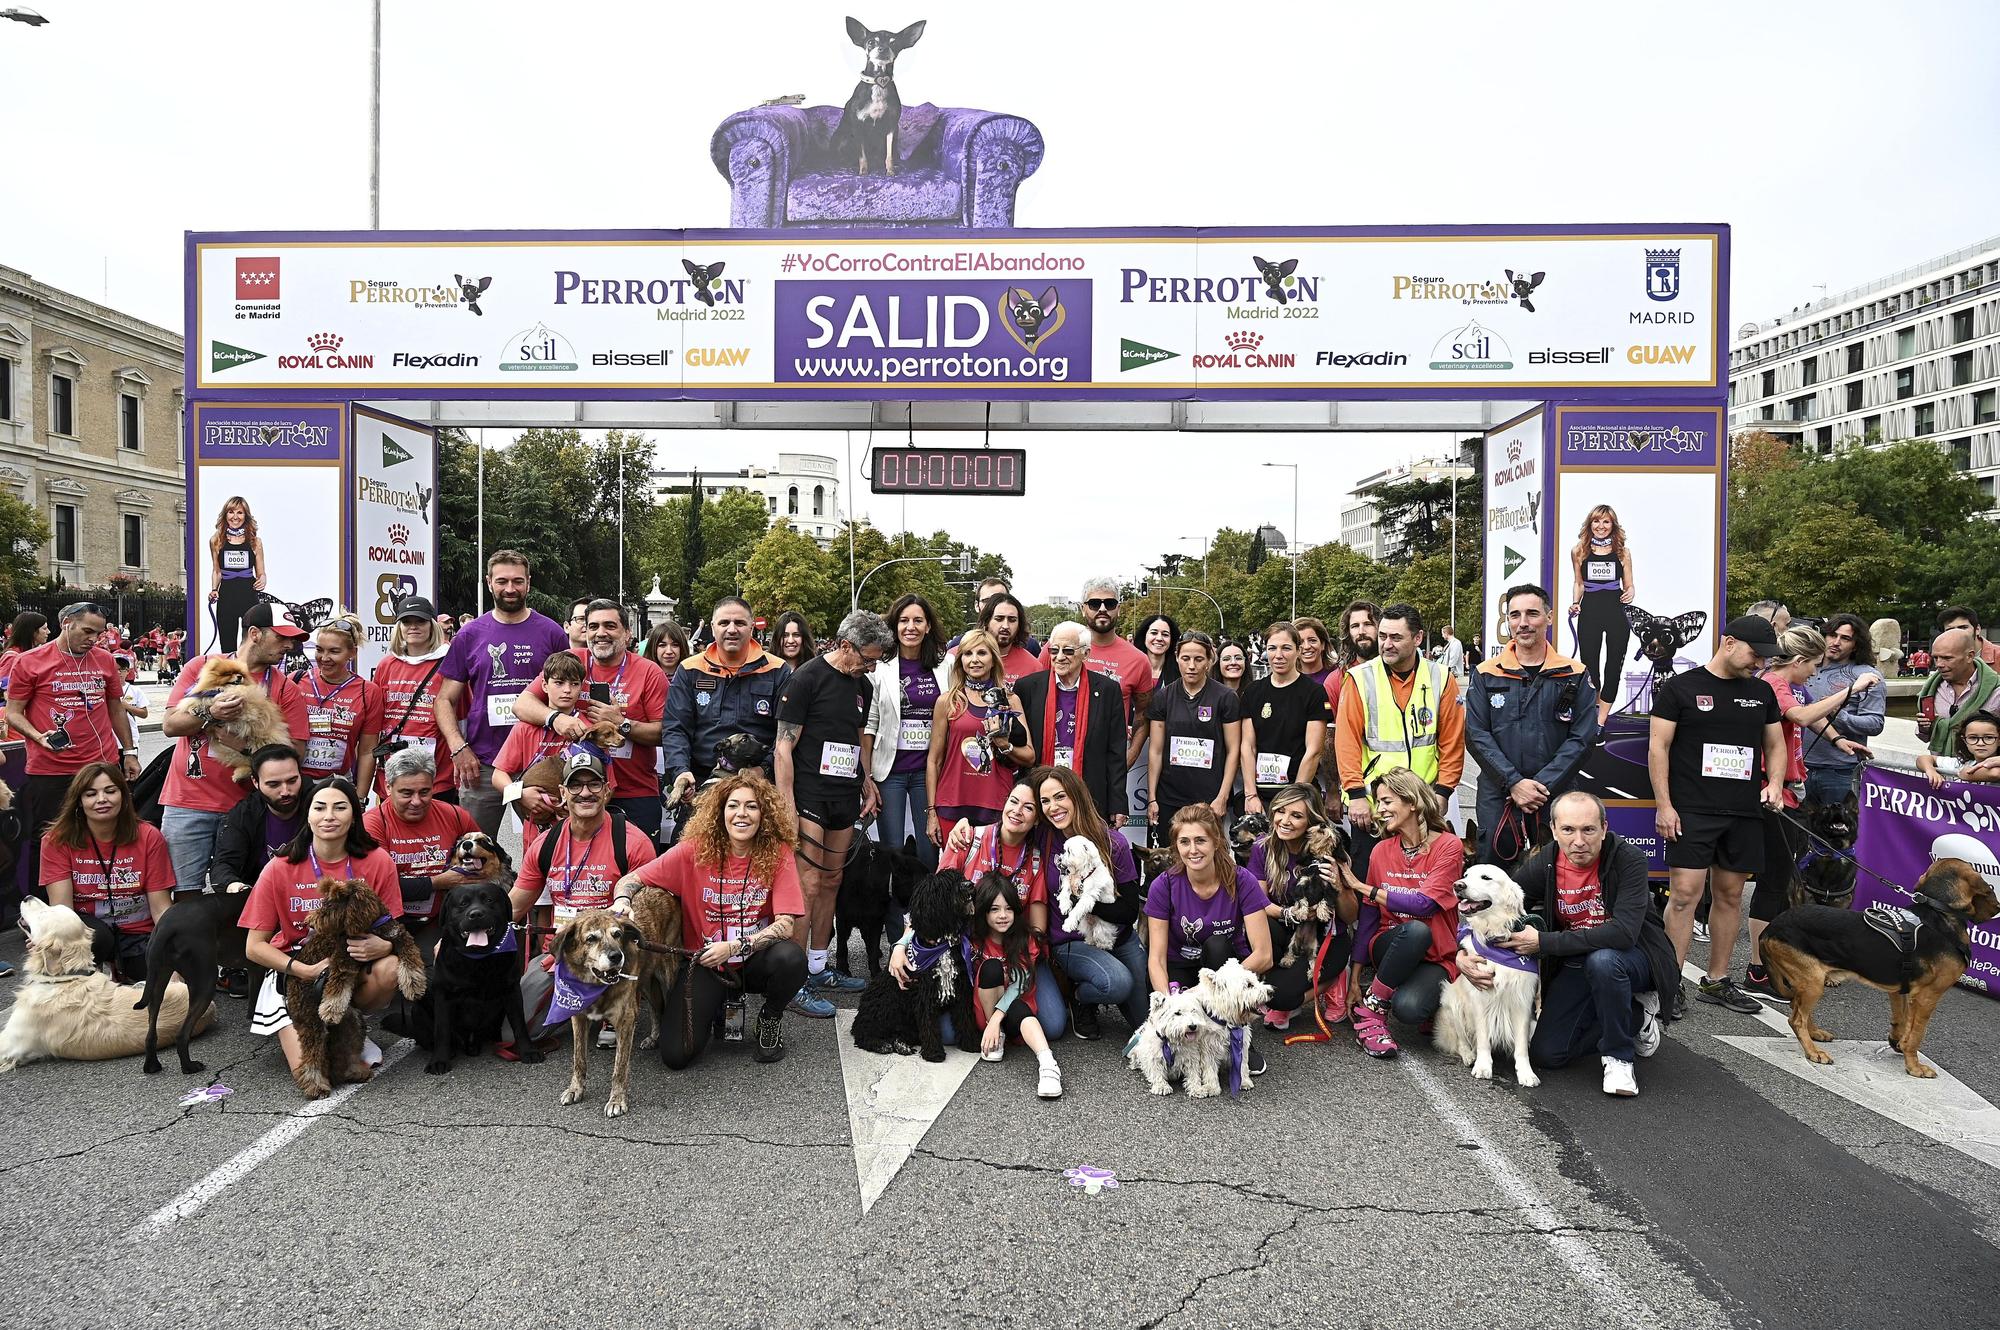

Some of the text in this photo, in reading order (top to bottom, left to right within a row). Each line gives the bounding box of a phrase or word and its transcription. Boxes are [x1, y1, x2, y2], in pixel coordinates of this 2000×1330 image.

[781, 252, 1085, 272] #YoCorroContraElAbandono
[1412, 276, 1444, 284] Seguro
[657, 308, 745, 321] Madrid 2022
[806, 294, 990, 349] SALID
[1227, 306, 1319, 319] Madrid 2022
[1630, 312, 1695, 324] MADRID
[521, 339, 556, 361] scil
[1452, 336, 1490, 360] scil
[1627, 345, 1696, 364] GUAW
[278, 355, 374, 369] ROYAL CANIN
[393, 353, 479, 369] Flexadin
[685, 348, 750, 367] GUAW
[1192, 354, 1295, 368] ROYAL CANIN
[1316, 351, 1407, 368] Flexadin
[794, 353, 1068, 382] www.perroton.org
[882, 455, 1014, 487] 00:00:00
[1494, 458, 1535, 487] ROYAL CANIN
[370, 478, 387, 488] Seguro
[369, 546, 425, 565] ROYAL CANIN
[902, 731, 931, 740] 0000
